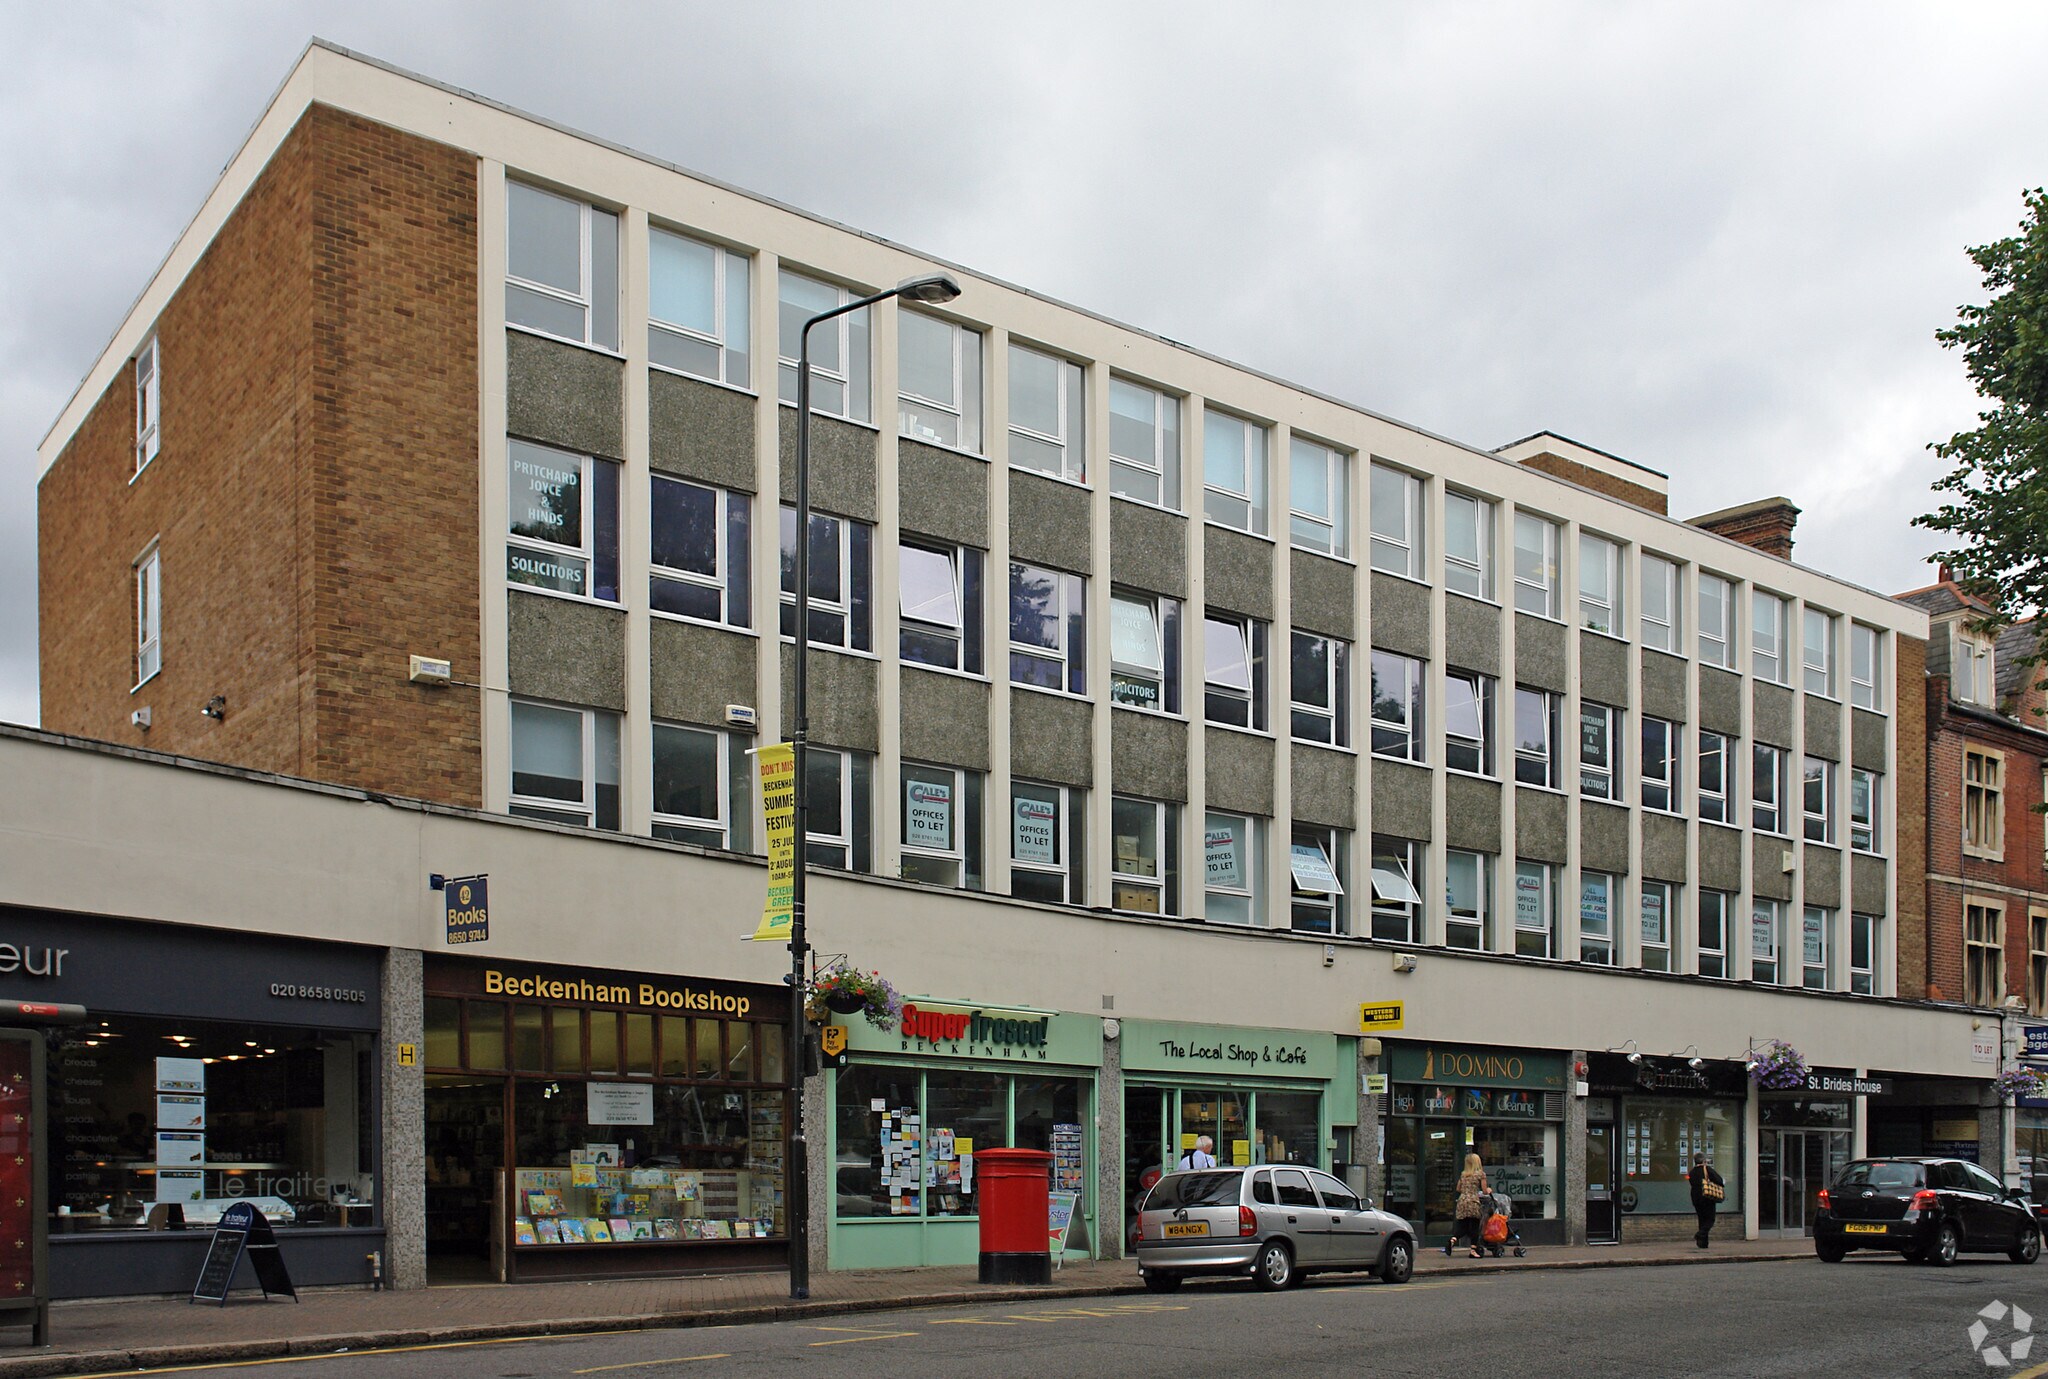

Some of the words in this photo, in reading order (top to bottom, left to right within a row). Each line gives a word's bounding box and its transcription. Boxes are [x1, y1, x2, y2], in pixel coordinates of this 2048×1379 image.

[514, 460, 577, 486] PRITCHARD
[529, 479, 562, 497] JOYCE
[540, 496, 551, 508] &
[528, 508, 564, 526] HINDS
[511, 557, 582, 582] SOLICITORS
[1120, 616, 1142, 630] JOYCE
[761, 763, 780, 776] DON'T
[782, 761, 794, 773] MIS
[764, 779, 795, 791] BECKENHA
[764, 794, 794, 811] SUMME
[912, 808, 945, 820] OFFICES
[766, 814, 795, 831] FESTIVA
[912, 819, 925, 829] TO
[928, 822, 944, 831] LET
[1019, 825, 1049, 836] OFFICES
[782, 836, 795, 847] JUL
[1020, 835, 1031, 844] TO
[1034, 837, 1049, 846] LET
[1206, 852, 1232, 862] OFFICES
[776, 859, 793, 869] AUGU
[1208, 863, 1218, 872] TO
[1220, 861, 1233, 870] LET
[767, 887, 794, 897] BECKENH
[1517, 895, 1537, 904] OFFICES
[1518, 903, 1525, 911] TO
[448, 906, 487, 926] Books
[271, 983, 296, 997] 020
[299, 986, 331, 1000] 8658
[334, 989, 366, 1002] 0505
[485, 970, 632, 1004] Beckenham
[638, 984, 752, 1018] Bookshop
[2029, 1031, 2048, 1041] est
[400, 1046, 414, 1064] H
[901, 1041, 1047, 1060] BECKENHAM
[1159, 1041, 1185, 1058] The
[1189, 1042, 1223, 1060] Local
[1227, 1044, 1258, 1068] Shop
[1262, 1046, 1273, 1061] &
[1275, 1047, 1307, 1064] iCafé
[1974, 1044, 1983, 1054] TO
[1984, 1046, 1993, 1055] LET
[65, 1058, 97, 1069] breads
[1442, 1053, 1523, 1080] DOMINO
[65, 1078, 103, 1088] cheeses
[1808, 1075, 1821, 1090] St.
[1823, 1077, 1852, 1092] Brides
[1854, 1079, 1882, 1094] House
[1395, 1094, 1415, 1112] High
[1425, 1095, 1455, 1115] quality
[1468, 1099, 1486, 1115] Dry
[1498, 1097, 1534, 1117] Cleaning
[65, 1115, 94, 1124] salads
[65, 1134, 119, 1143] charcuterie
[66, 1170, 101, 1181] pastries
[220, 1171, 245, 1198] le
[1496, 1181, 1551, 1195] Cleaners
[1048, 1210, 1070, 1219] yster
[1168, 1225, 1185, 1235] W84
[1185, 1225, 1203, 1234] NGX
